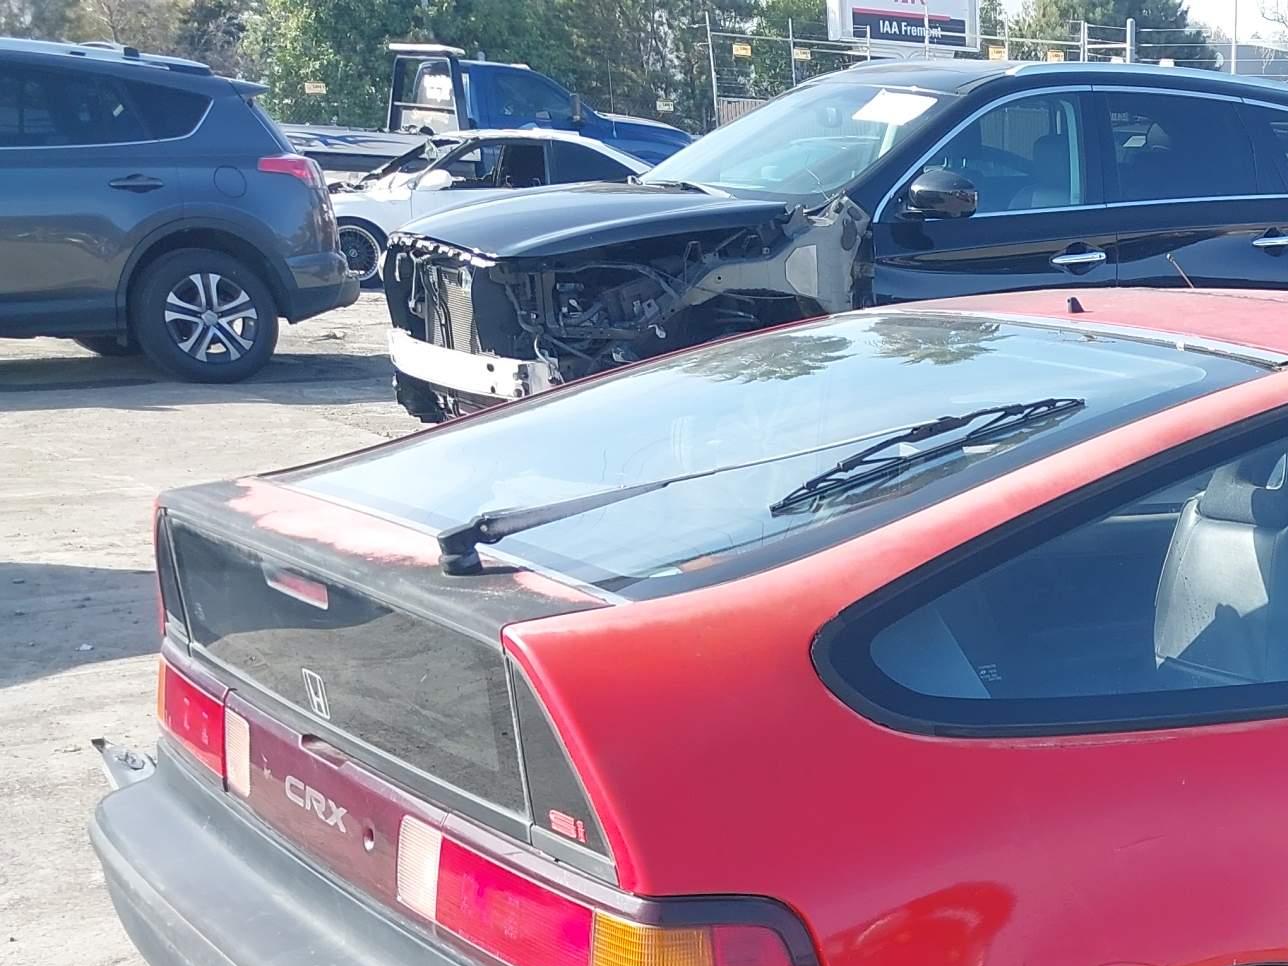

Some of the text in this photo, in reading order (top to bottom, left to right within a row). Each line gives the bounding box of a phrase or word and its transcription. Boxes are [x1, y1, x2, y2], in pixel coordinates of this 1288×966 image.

[880, 20, 942, 39] IAA Fremont
[285, 775, 348, 834] CRX
